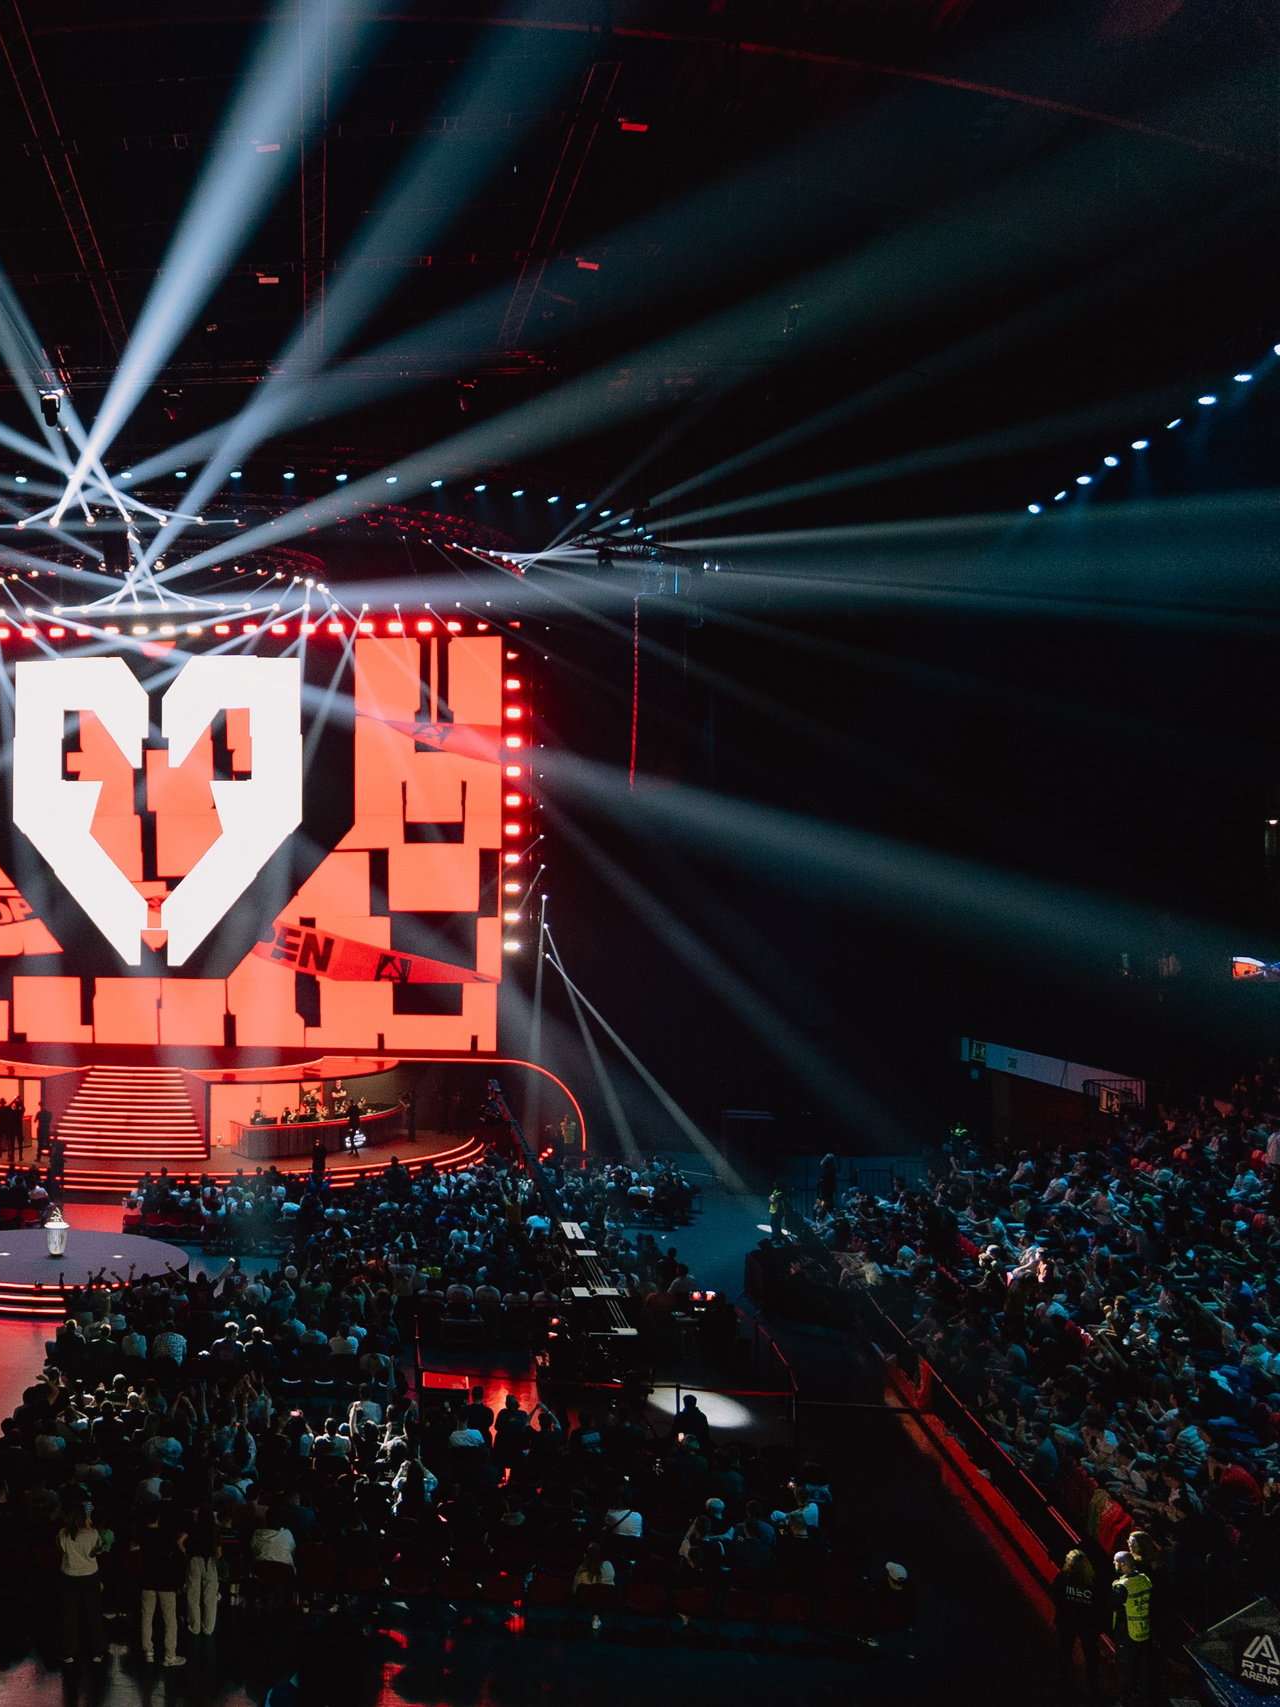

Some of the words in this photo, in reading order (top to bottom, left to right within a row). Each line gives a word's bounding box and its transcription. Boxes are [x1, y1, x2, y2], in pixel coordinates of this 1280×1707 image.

[1065, 1586, 1093, 1599] MEO
[1241, 1659, 1280, 1676] RTP
[1240, 1669, 1279, 1687] ARENA
